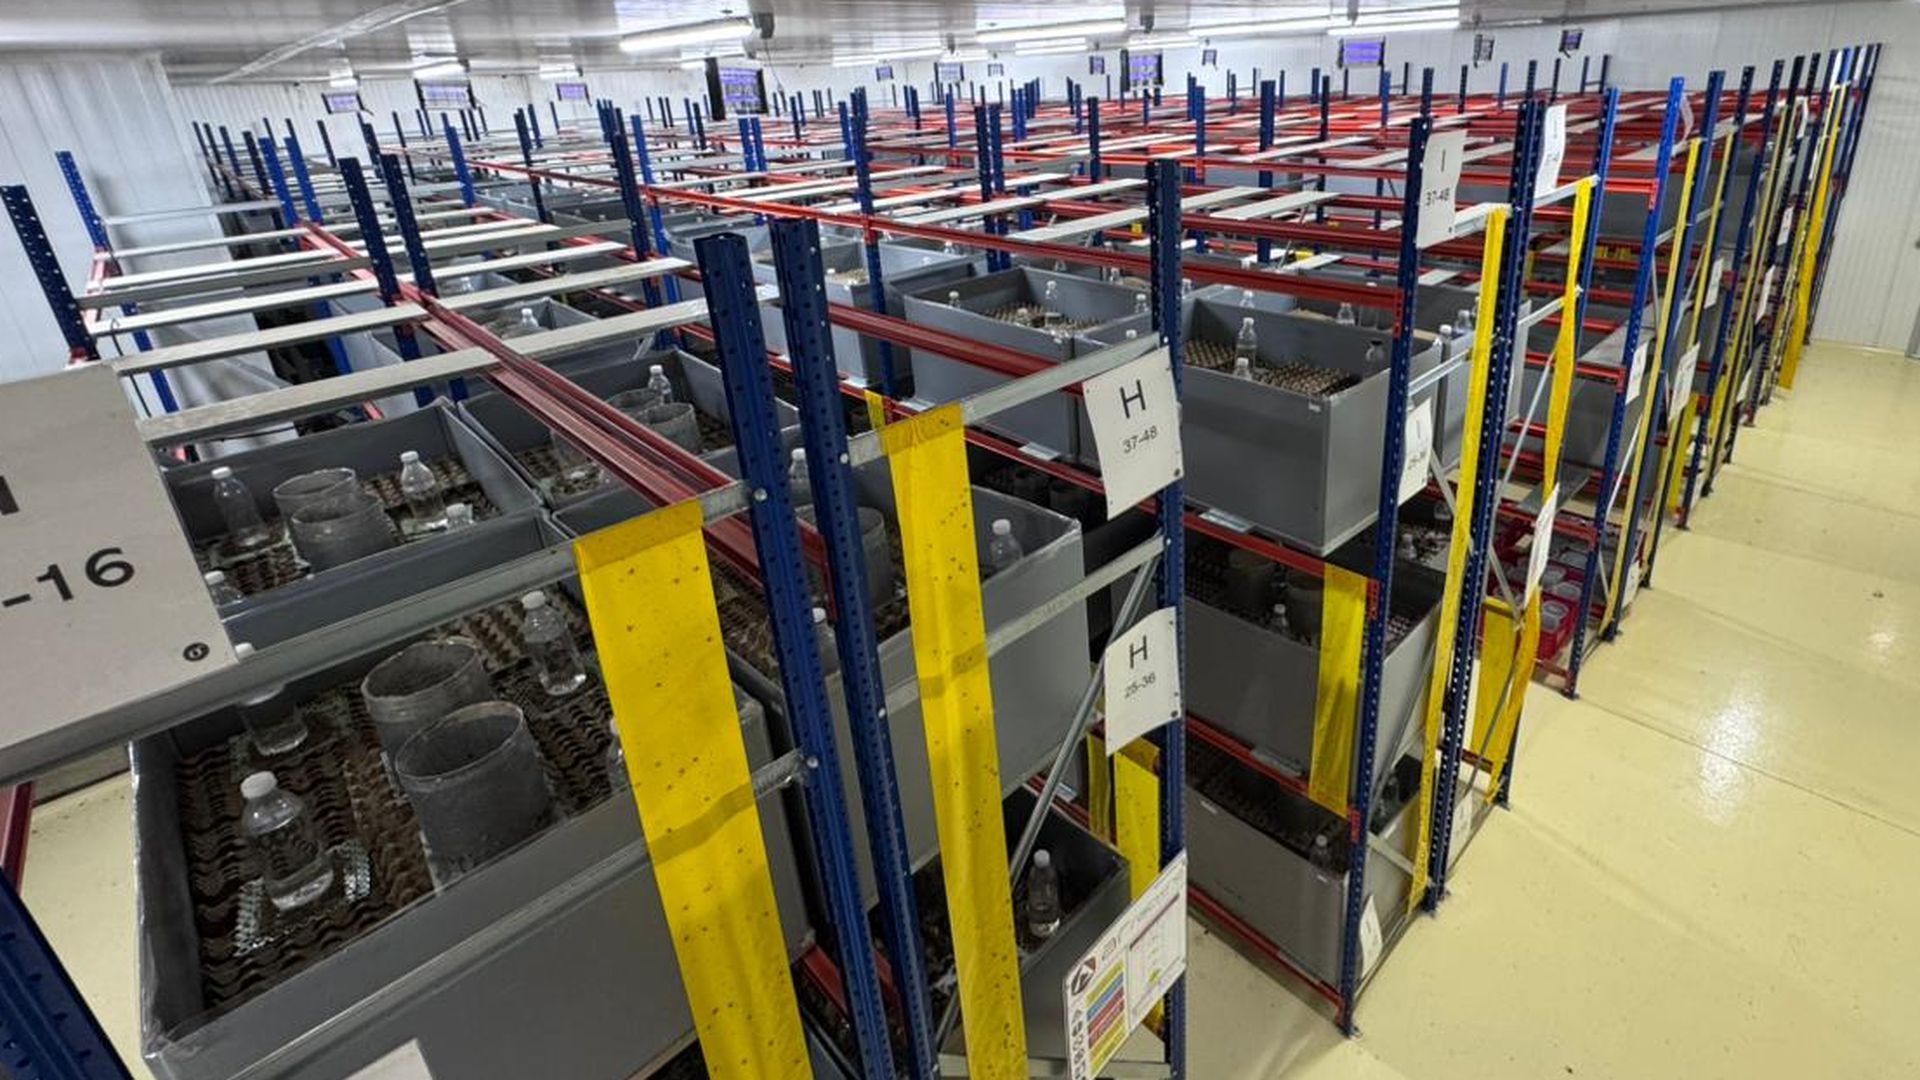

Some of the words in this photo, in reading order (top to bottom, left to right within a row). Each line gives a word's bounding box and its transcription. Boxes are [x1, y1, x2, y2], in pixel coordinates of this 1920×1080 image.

[1120, 379, 1146, 419] H
[1122, 425, 1158, 454] 37-48
[1129, 634, 1147, 669] H
[1124, 671, 1156, 699] 25-36
